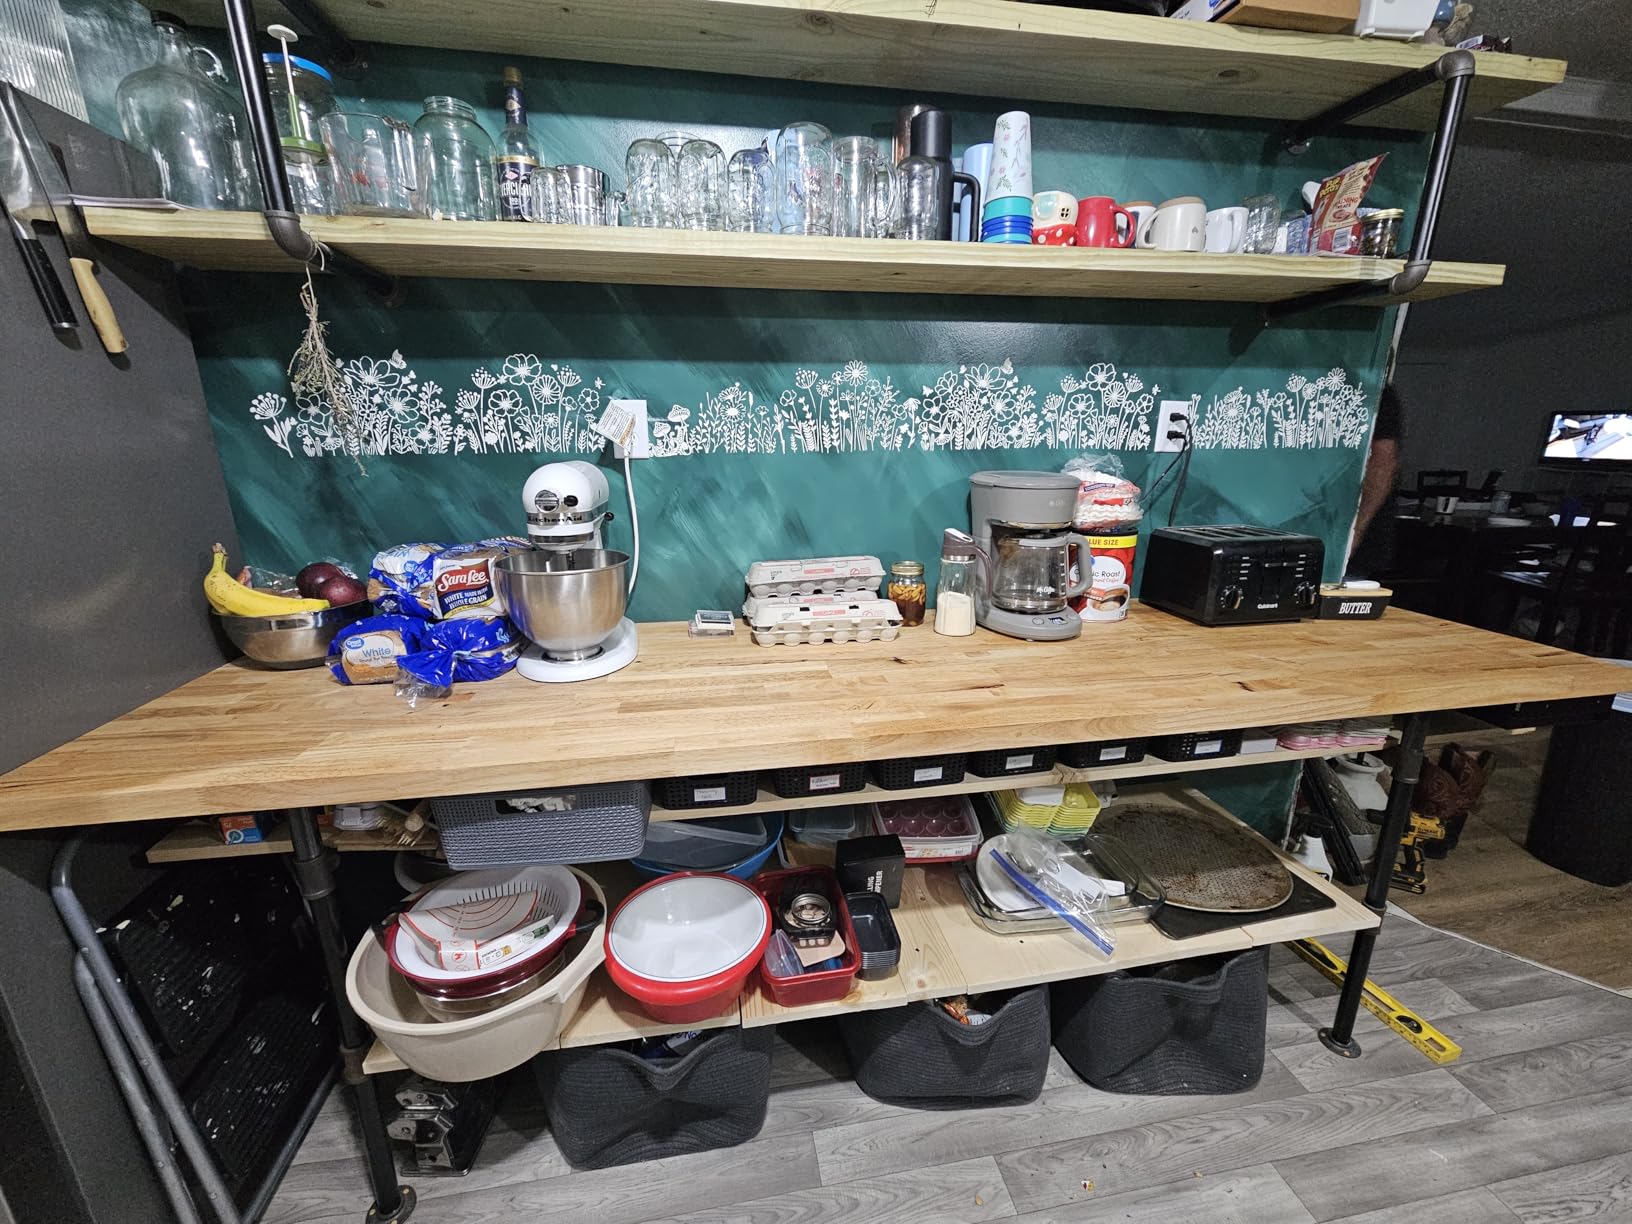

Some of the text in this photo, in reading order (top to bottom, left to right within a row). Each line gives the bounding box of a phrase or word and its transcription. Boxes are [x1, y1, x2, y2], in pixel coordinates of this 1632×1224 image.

[1103, 538, 1119, 546] SIZE
[437, 569, 489, 592] Sara Lee
[444, 591, 464, 604] WHITE
[448, 598, 468, 609] WHOLE
[468, 594, 488, 604] GRAIN
[1338, 602, 1373, 614] BUTTER
[362, 647, 391, 657] White
